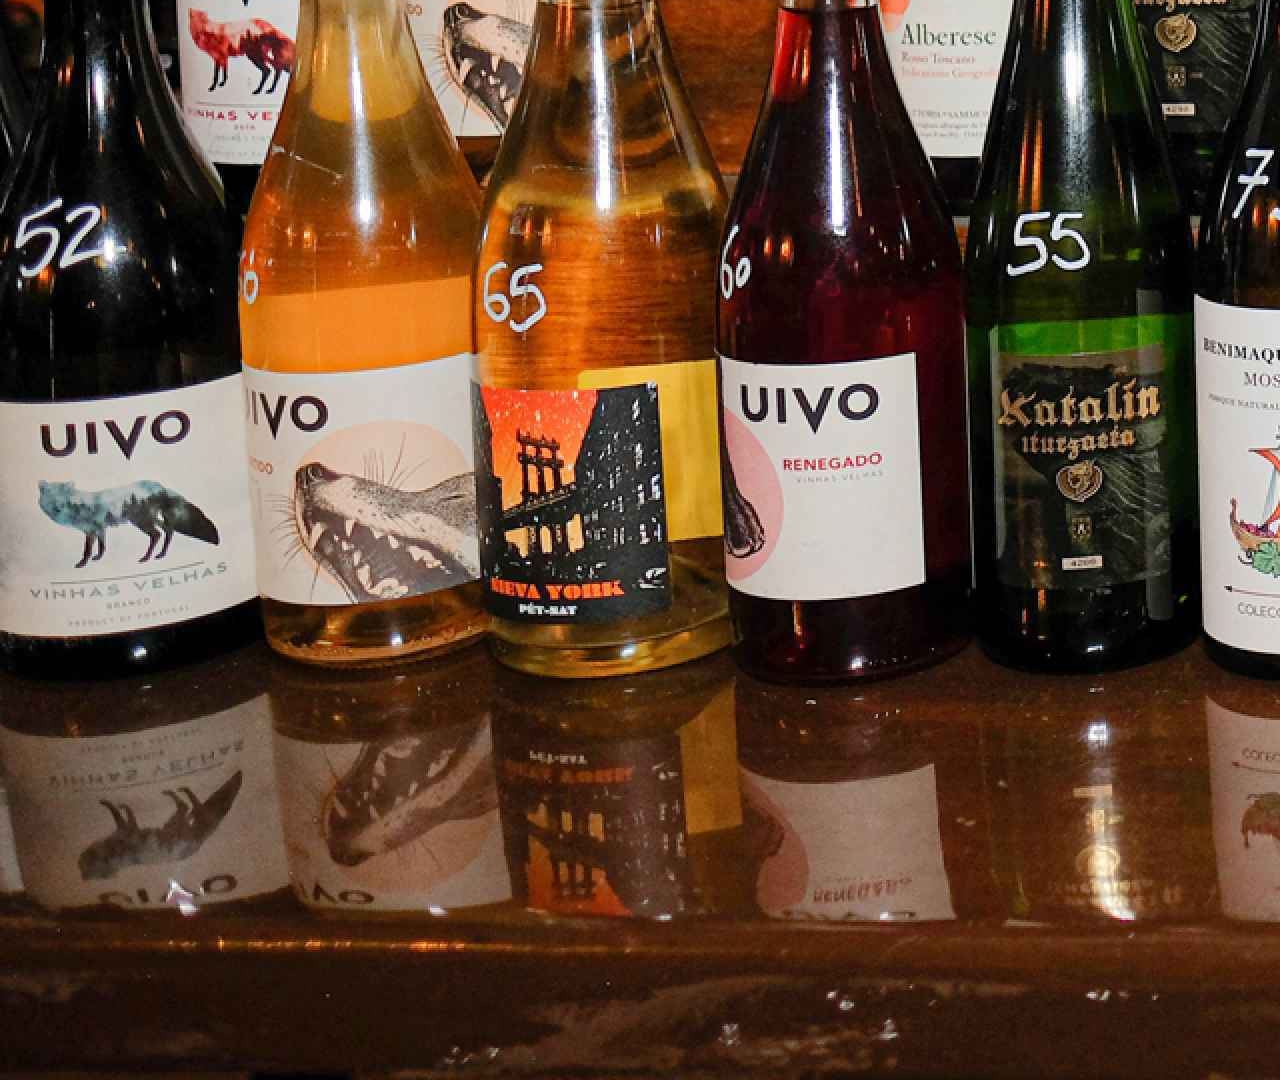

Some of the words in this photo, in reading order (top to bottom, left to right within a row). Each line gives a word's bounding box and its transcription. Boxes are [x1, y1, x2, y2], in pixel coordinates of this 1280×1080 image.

[901, 23, 997, 46] Alberese
[14, 198, 120, 280] 52
[720, 224, 751, 299] 60
[1007, 211, 1091, 277] 55
[484, 260, 548, 334] 65
[740, 383, 880, 434] UIVO
[998, 378, 1162, 427] Katalín
[39, 409, 192, 460] UIVO
[782, 452, 884, 472] RENEGADO
[29, 583, 122, 602] VINHAS
[133, 560, 229, 593] VELHAS
[545, 579, 624, 598] YORK
[519, 602, 577, 616] PÉT-NAT
